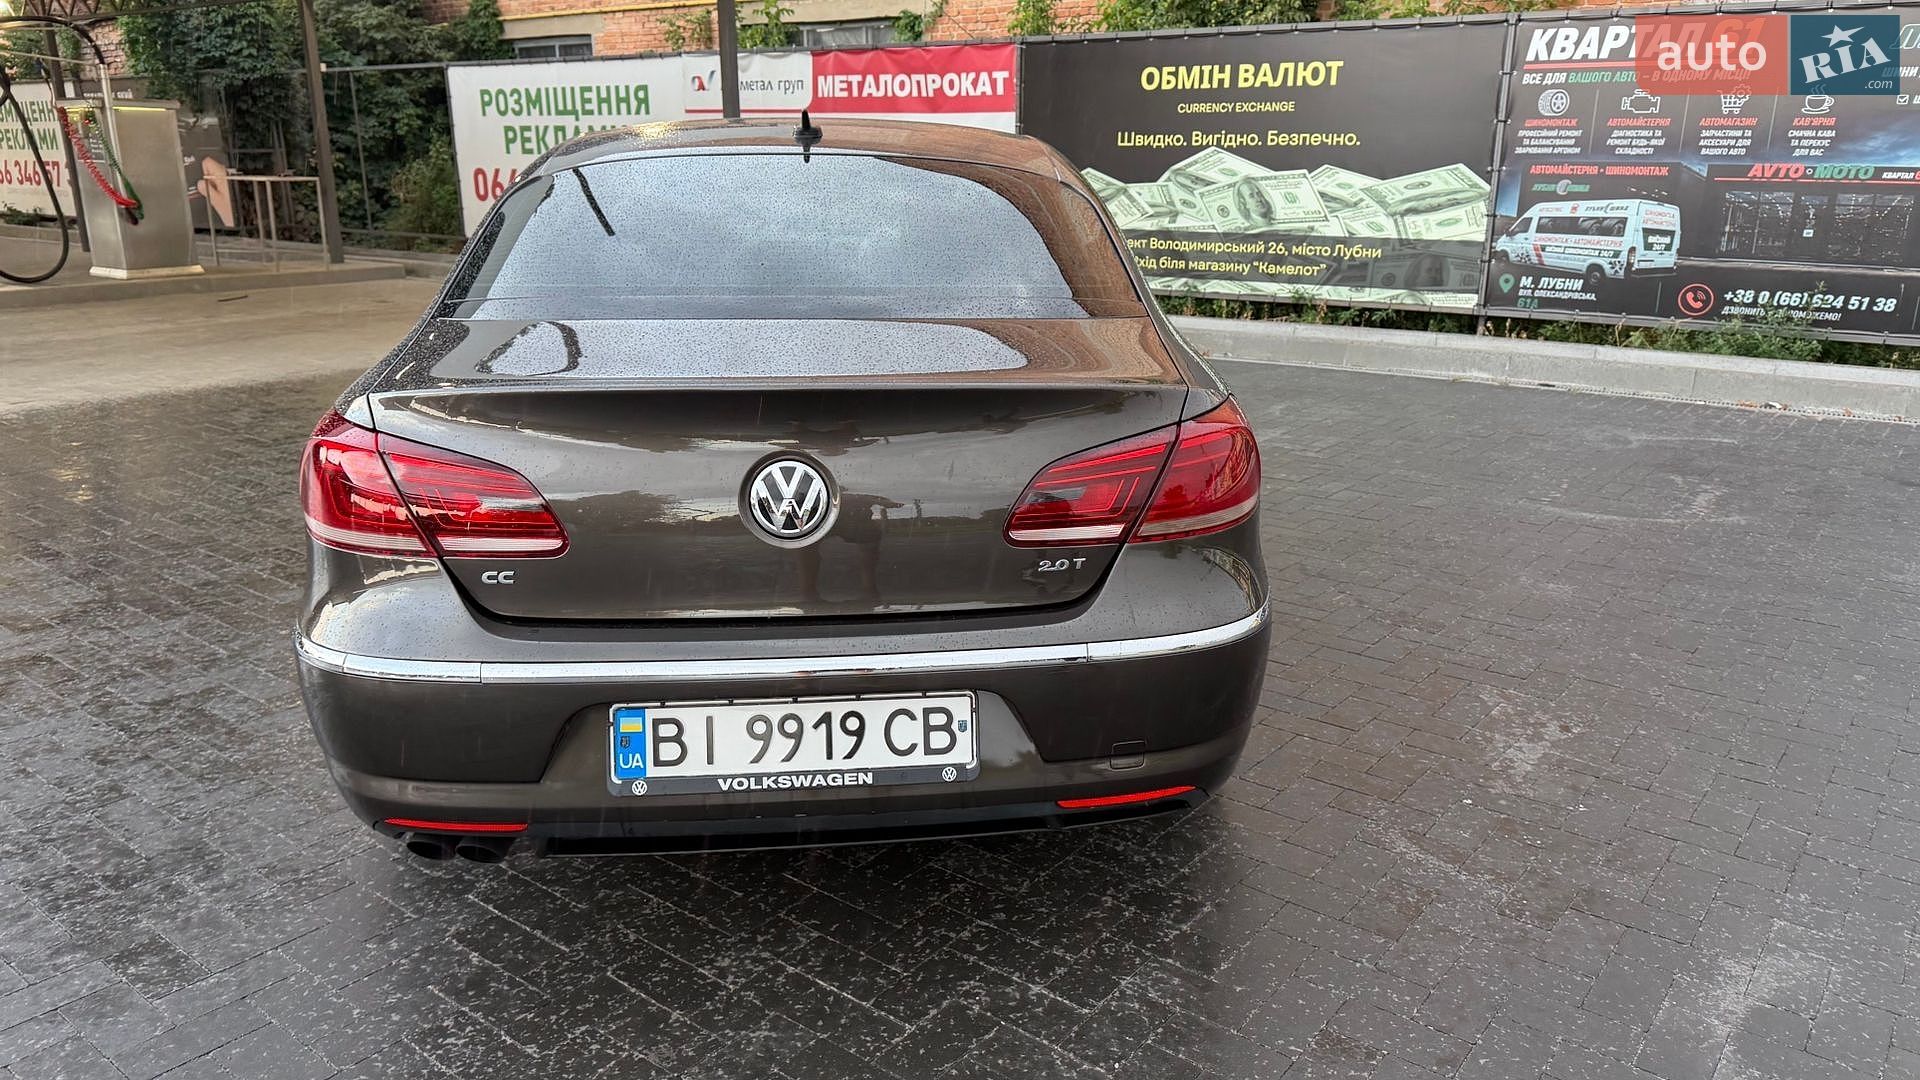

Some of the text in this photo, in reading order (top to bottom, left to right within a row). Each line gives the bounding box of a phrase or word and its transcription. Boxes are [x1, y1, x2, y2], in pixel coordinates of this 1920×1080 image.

[1140, 60, 1344, 91] ОБМІН ВАЛЮТ
[1522, 73, 1542, 85] ВСЕ
[1543, 73, 1567, 86] ДЛЯ
[1568, 71, 1612, 84] ВАШОГО
[1613, 70, 1638, 82] АВТО
[778, 79, 804, 95] груп
[817, 71, 1010, 98] МЕТАЛОПРОКАТ
[479, 85, 651, 122] РОЗМІЩЕННЯ
[1177, 101, 1296, 114] CURRENCY EXCHANGE
[1524, 118, 1578, 127] ШИНОМОНТАЖ
[1607, 116, 1671, 126] АВТОМАЙСТЕРНЯ
[1699, 118, 1758, 126] АВТОМАГАЗИН
[1117, 130, 1360, 148] Швидко. Вигідно. Безпечно.
[14, 160, 41, 186] 346
[1530, 164, 1669, 176] АВТОМАЙСТЕРНЯ ШИНОМОНТАЖ
[1150, 237, 1265, 254] Володимирський
[1268, 242, 1288, 256] 26,
[1292, 242, 1331, 256] місто
[1332, 244, 1382, 260] Лубни
[1159, 255, 1186, 269] біля
[1188, 260, 1250, 275] магазину
[1520, 276, 1584, 291] М. ЛУБНИ
[1723, 289, 1897, 312] +38 0 (66) 624 51 38
[481, 571, 515, 584] CC
[745, 710, 865, 764] 9919
[883, 707, 957, 757] CB
[619, 753, 643, 769] UA
[718, 772, 873, 791] VOLKSWAGEN
